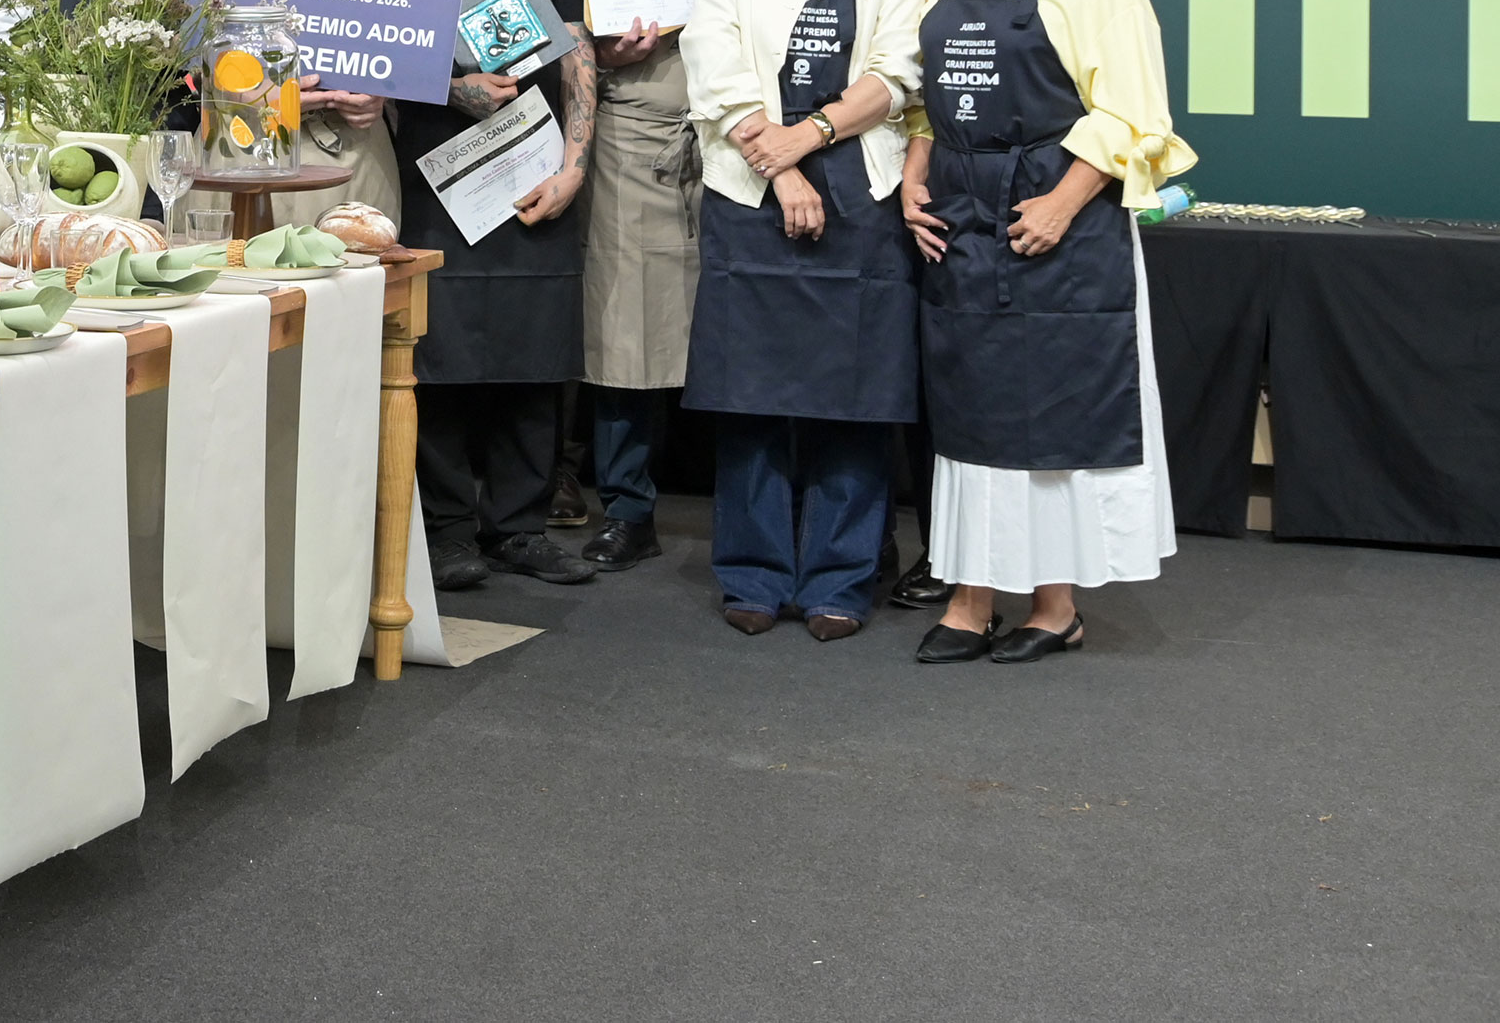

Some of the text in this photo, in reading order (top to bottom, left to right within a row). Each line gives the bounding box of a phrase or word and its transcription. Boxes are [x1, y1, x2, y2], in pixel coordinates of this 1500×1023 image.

[293, 13, 435, 48] REMIO ADOM
[803, 27, 836, 37] PREMIO
[960, 22, 986, 31] JURADO
[788, 38, 841, 52] DOM
[944, 47, 968, 55] MONTAJE
[300, 45, 393, 80] REMIO
[945, 60, 994, 69] GRAN PREMIO
[937, 71, 1000, 85] ADOM
